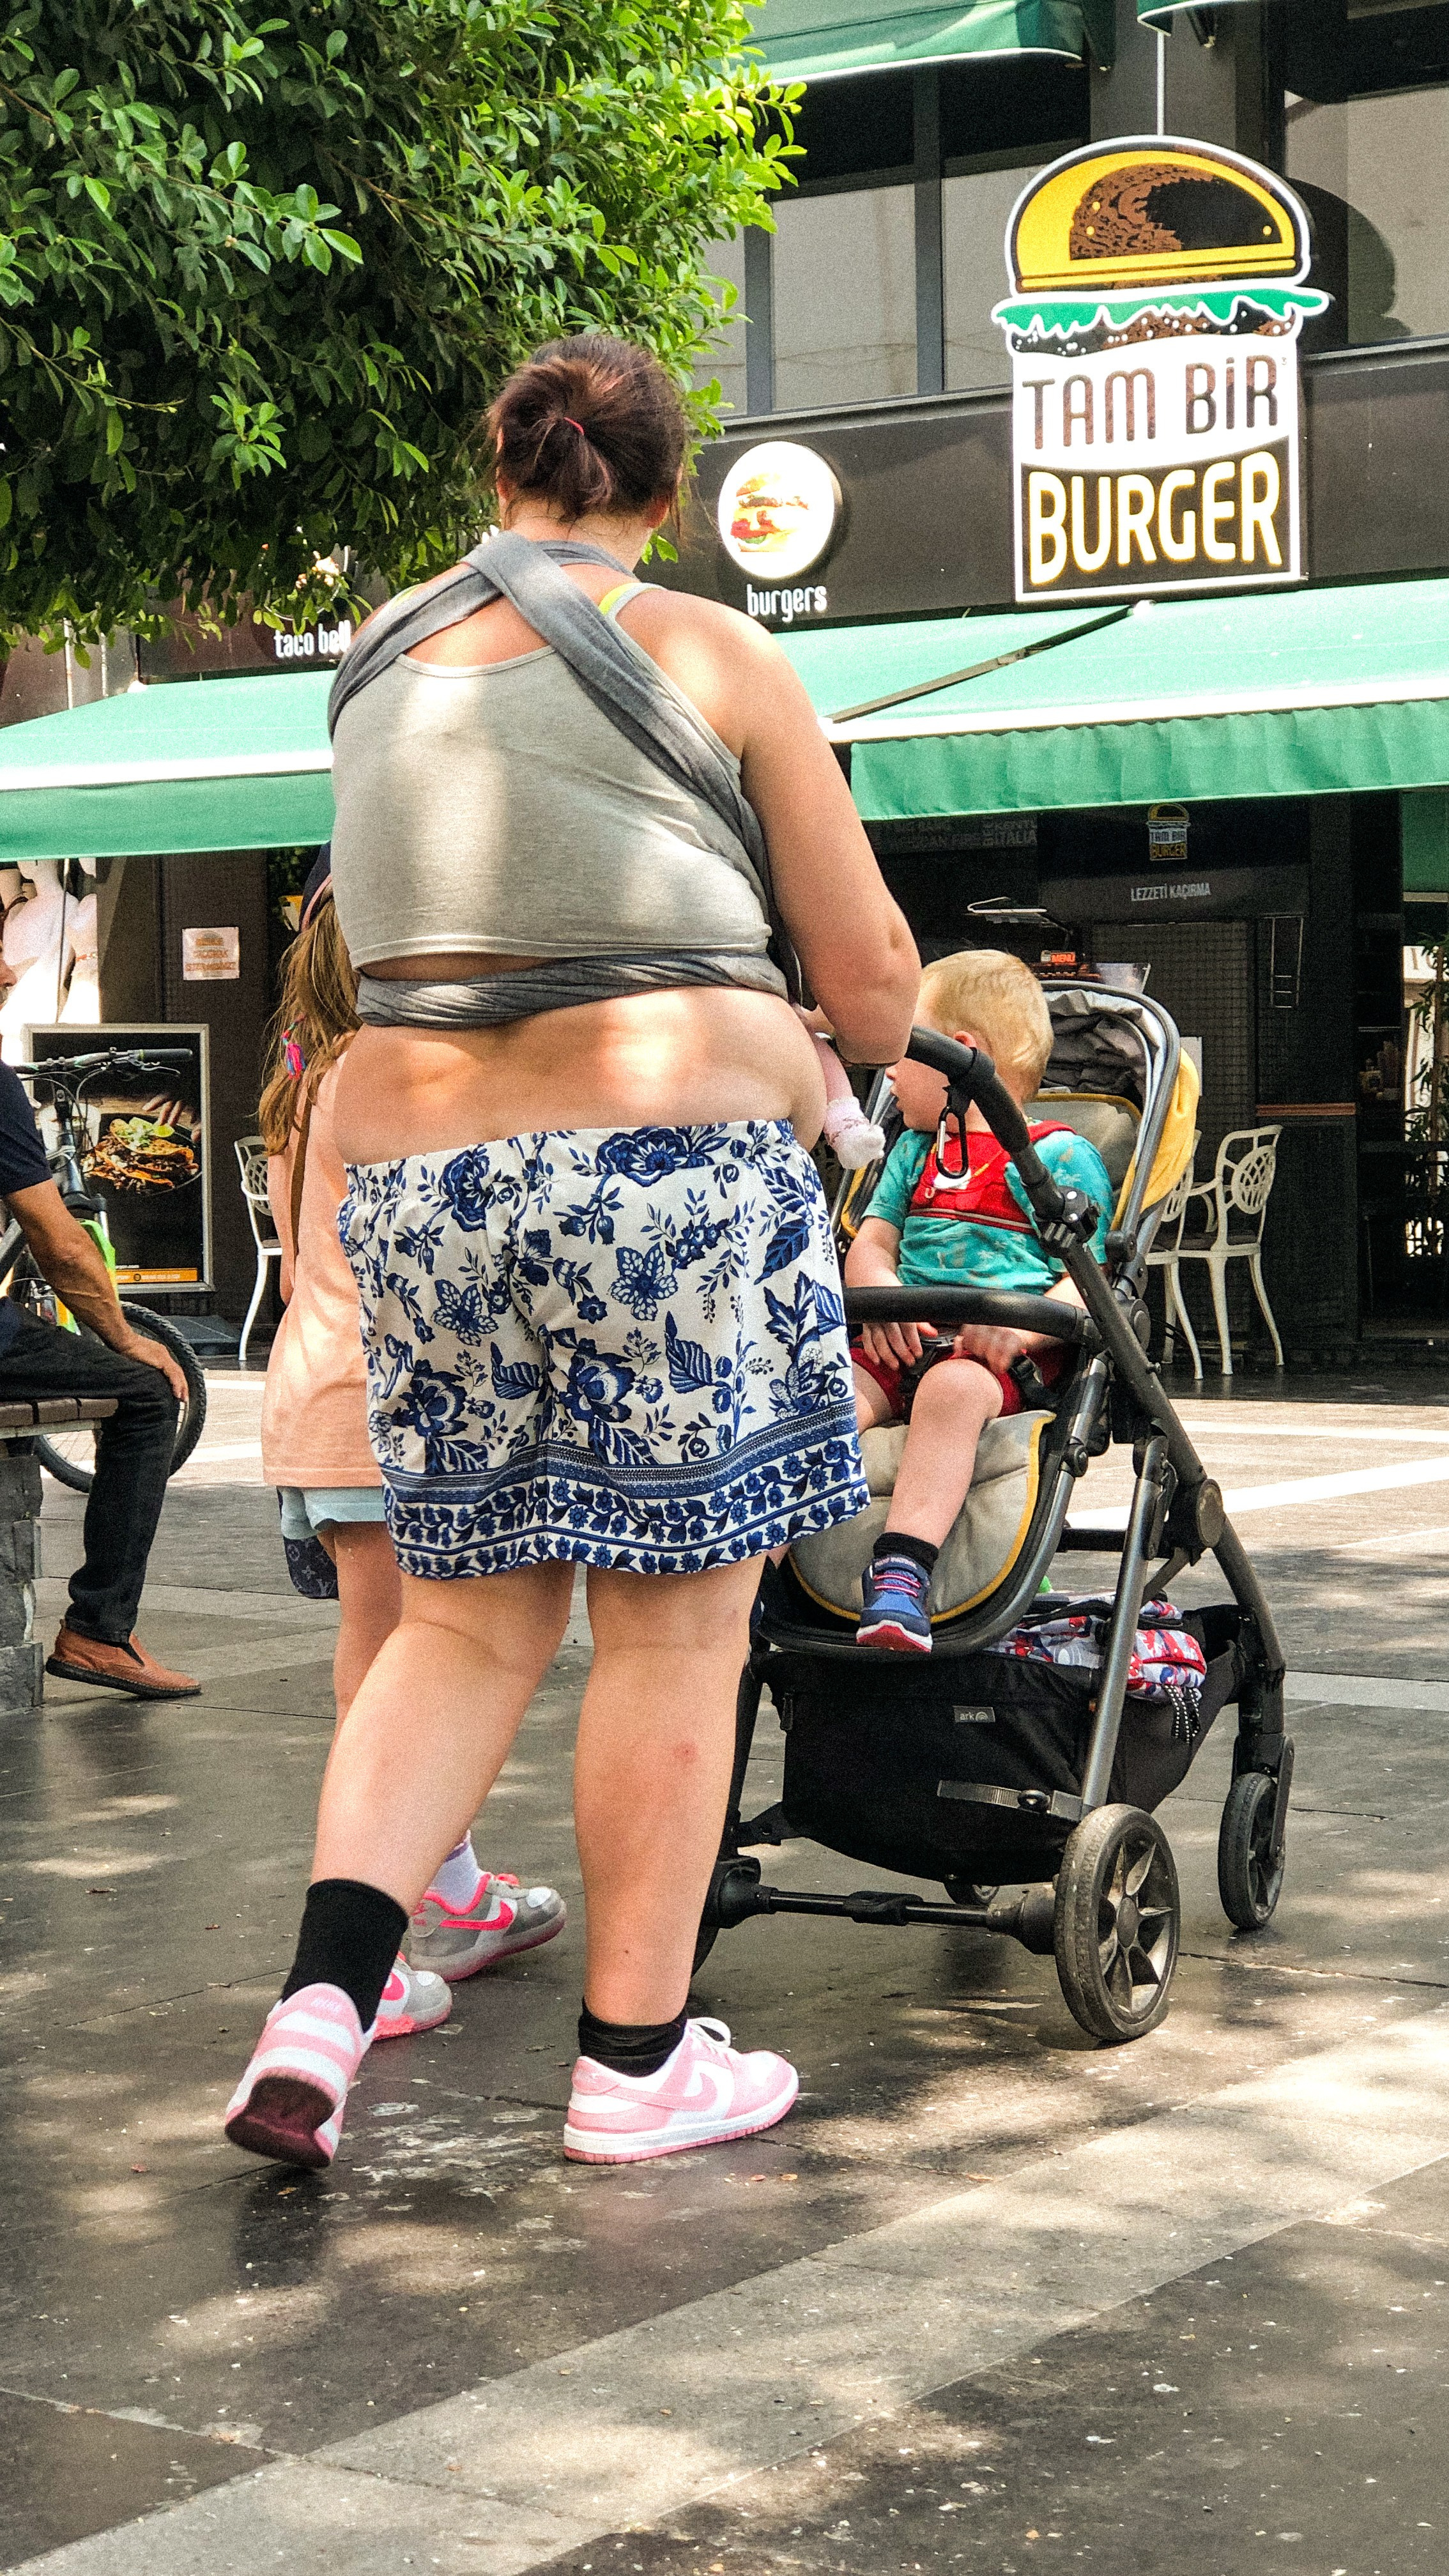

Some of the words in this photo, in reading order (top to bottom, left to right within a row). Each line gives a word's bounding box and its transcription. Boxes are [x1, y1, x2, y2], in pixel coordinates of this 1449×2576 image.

[1022, 367, 1156, 450] TAM
[1029, 451, 1283, 585] BURGER
[746, 583, 827, 622] burgers
[273, 629, 314, 657] taco
[318, 620, 351, 654] bell
[1151, 843, 1186, 858] BURGER
[1131, 883, 1168, 901] LEZZETİ
[1169, 882, 1211, 900] KAÇIRMA
